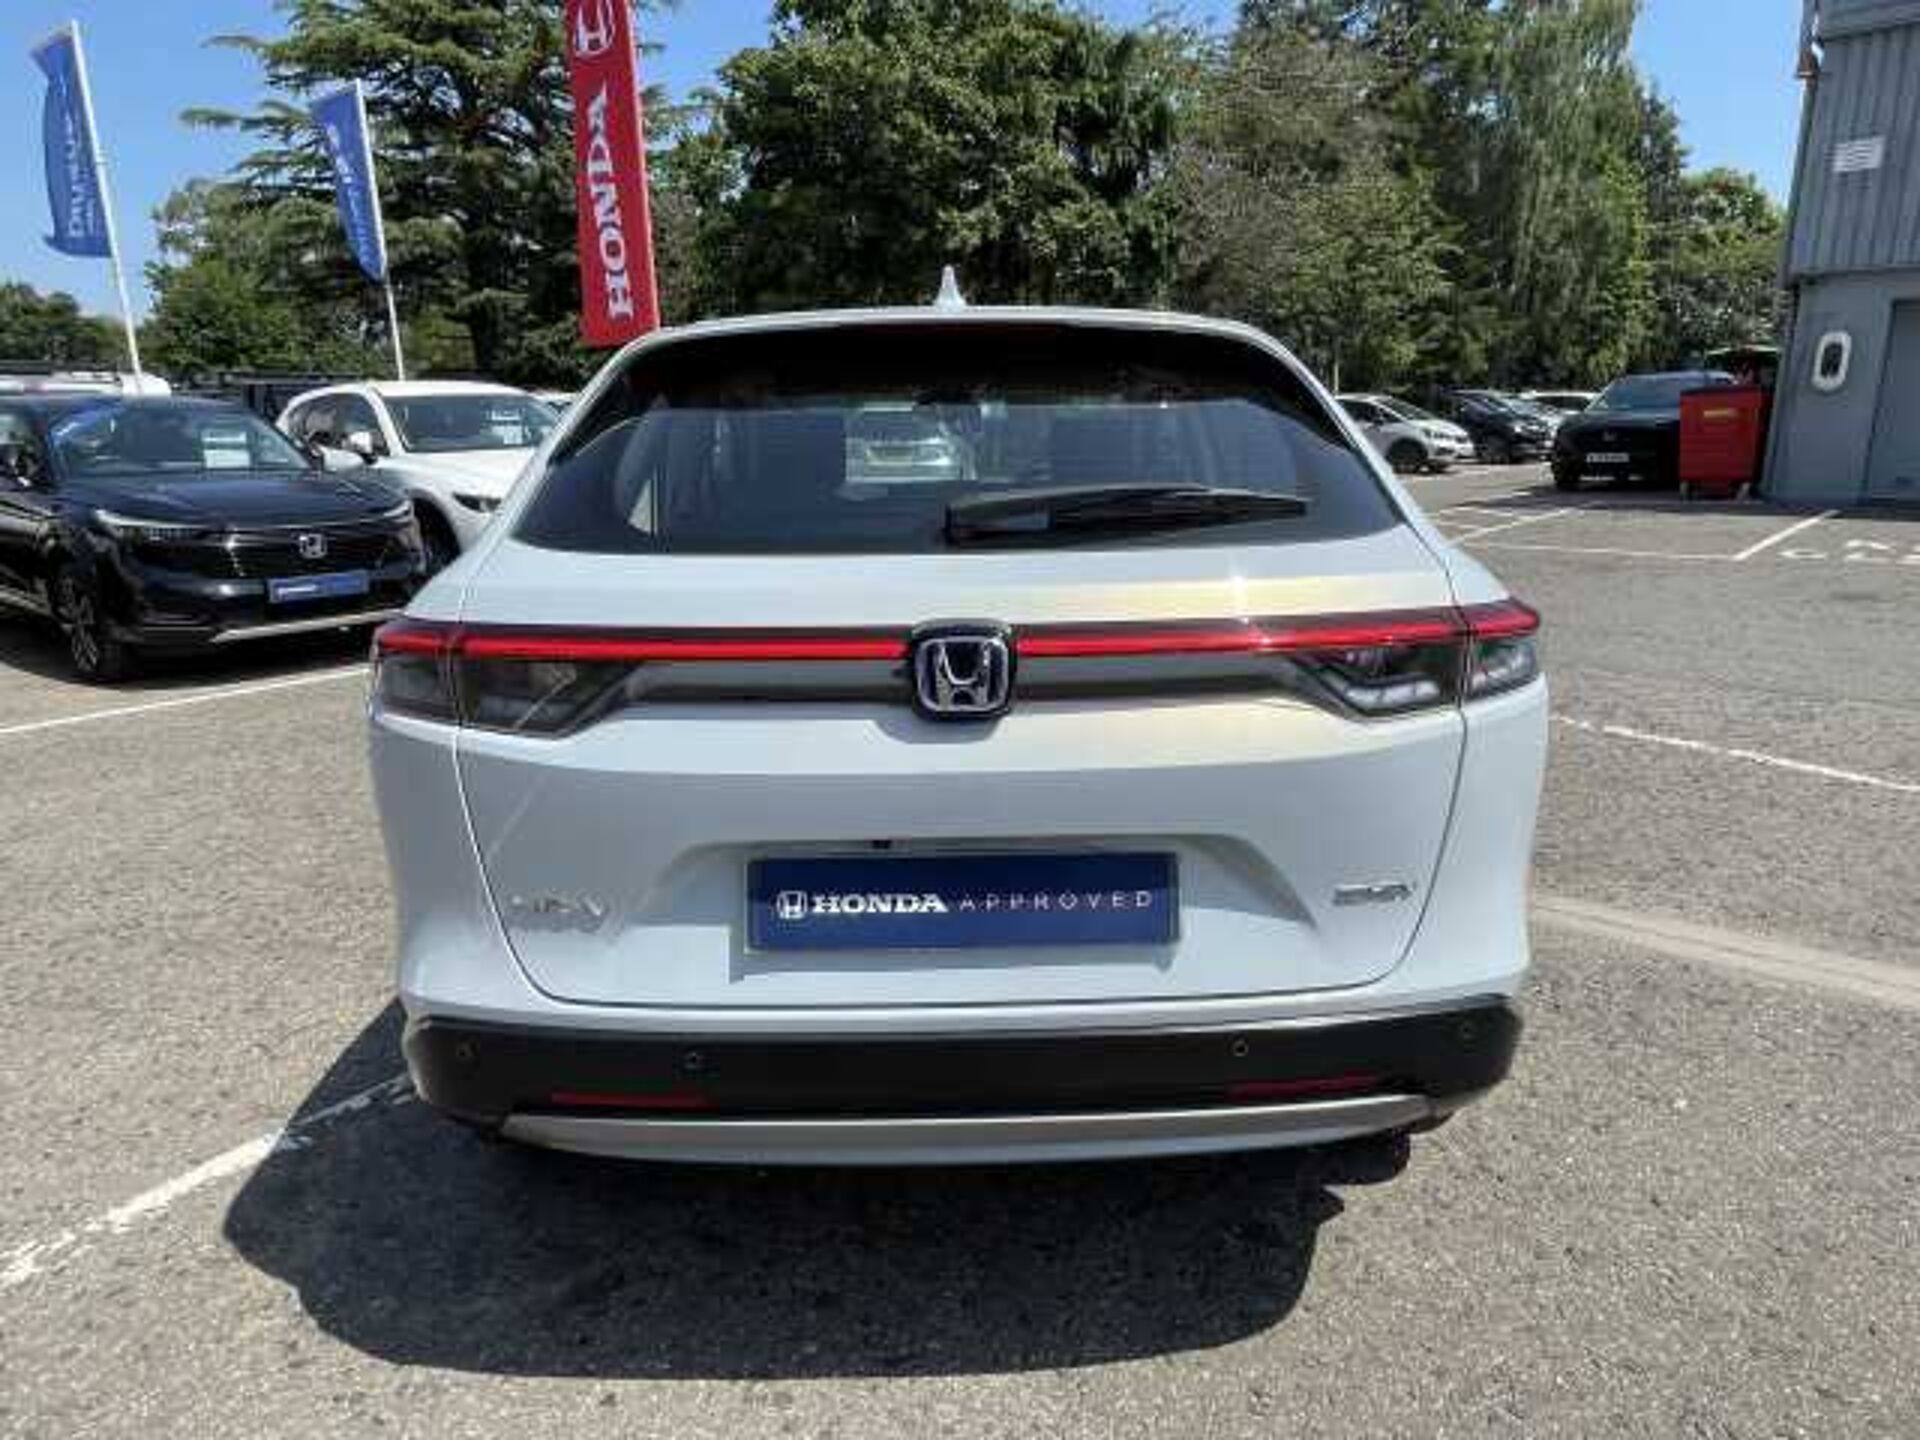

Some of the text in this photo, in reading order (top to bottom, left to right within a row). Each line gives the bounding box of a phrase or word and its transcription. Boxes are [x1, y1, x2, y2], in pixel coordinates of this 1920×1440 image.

[586, 79, 634, 320] HONDA
[812, 893, 948, 913] HONDA
[959, 890, 1152, 912] APPROVED
